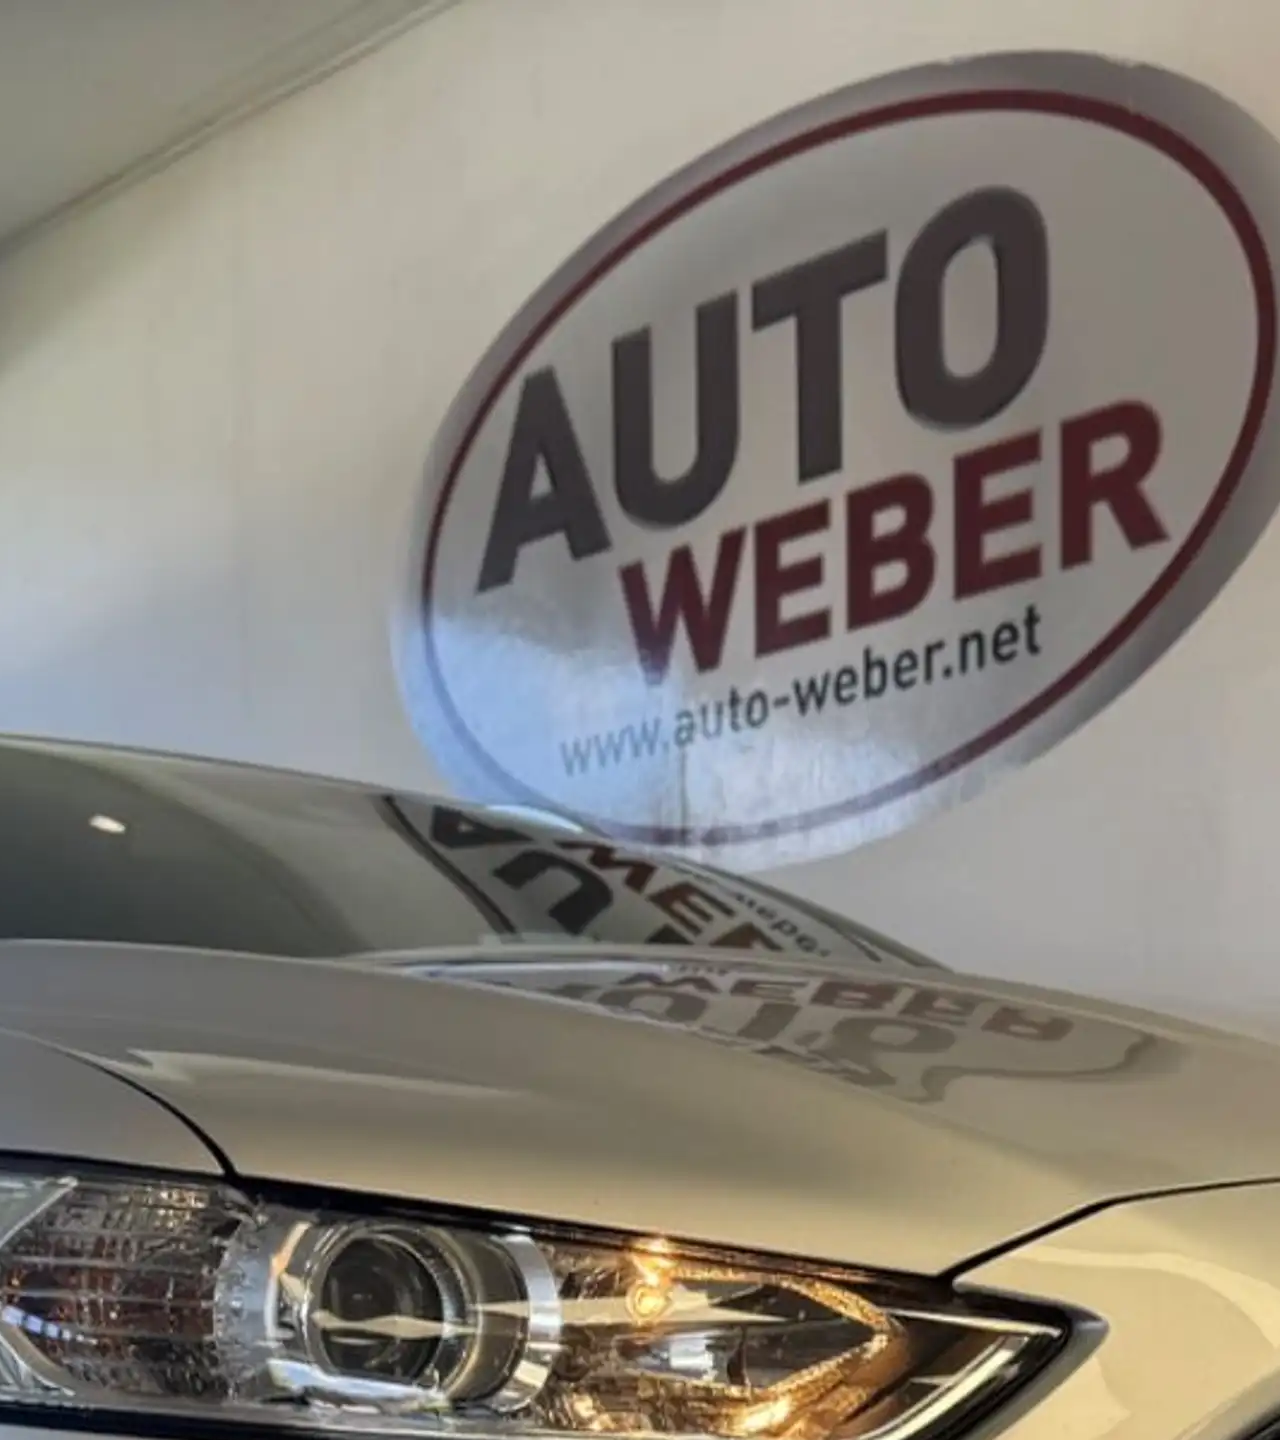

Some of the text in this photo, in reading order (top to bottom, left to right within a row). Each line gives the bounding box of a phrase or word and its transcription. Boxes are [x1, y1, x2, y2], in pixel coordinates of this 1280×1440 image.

[475, 184, 1049, 596] AUTO
[618, 398, 1172, 687] WEBER
[560, 603, 1043, 777] www.auto-weber.net
